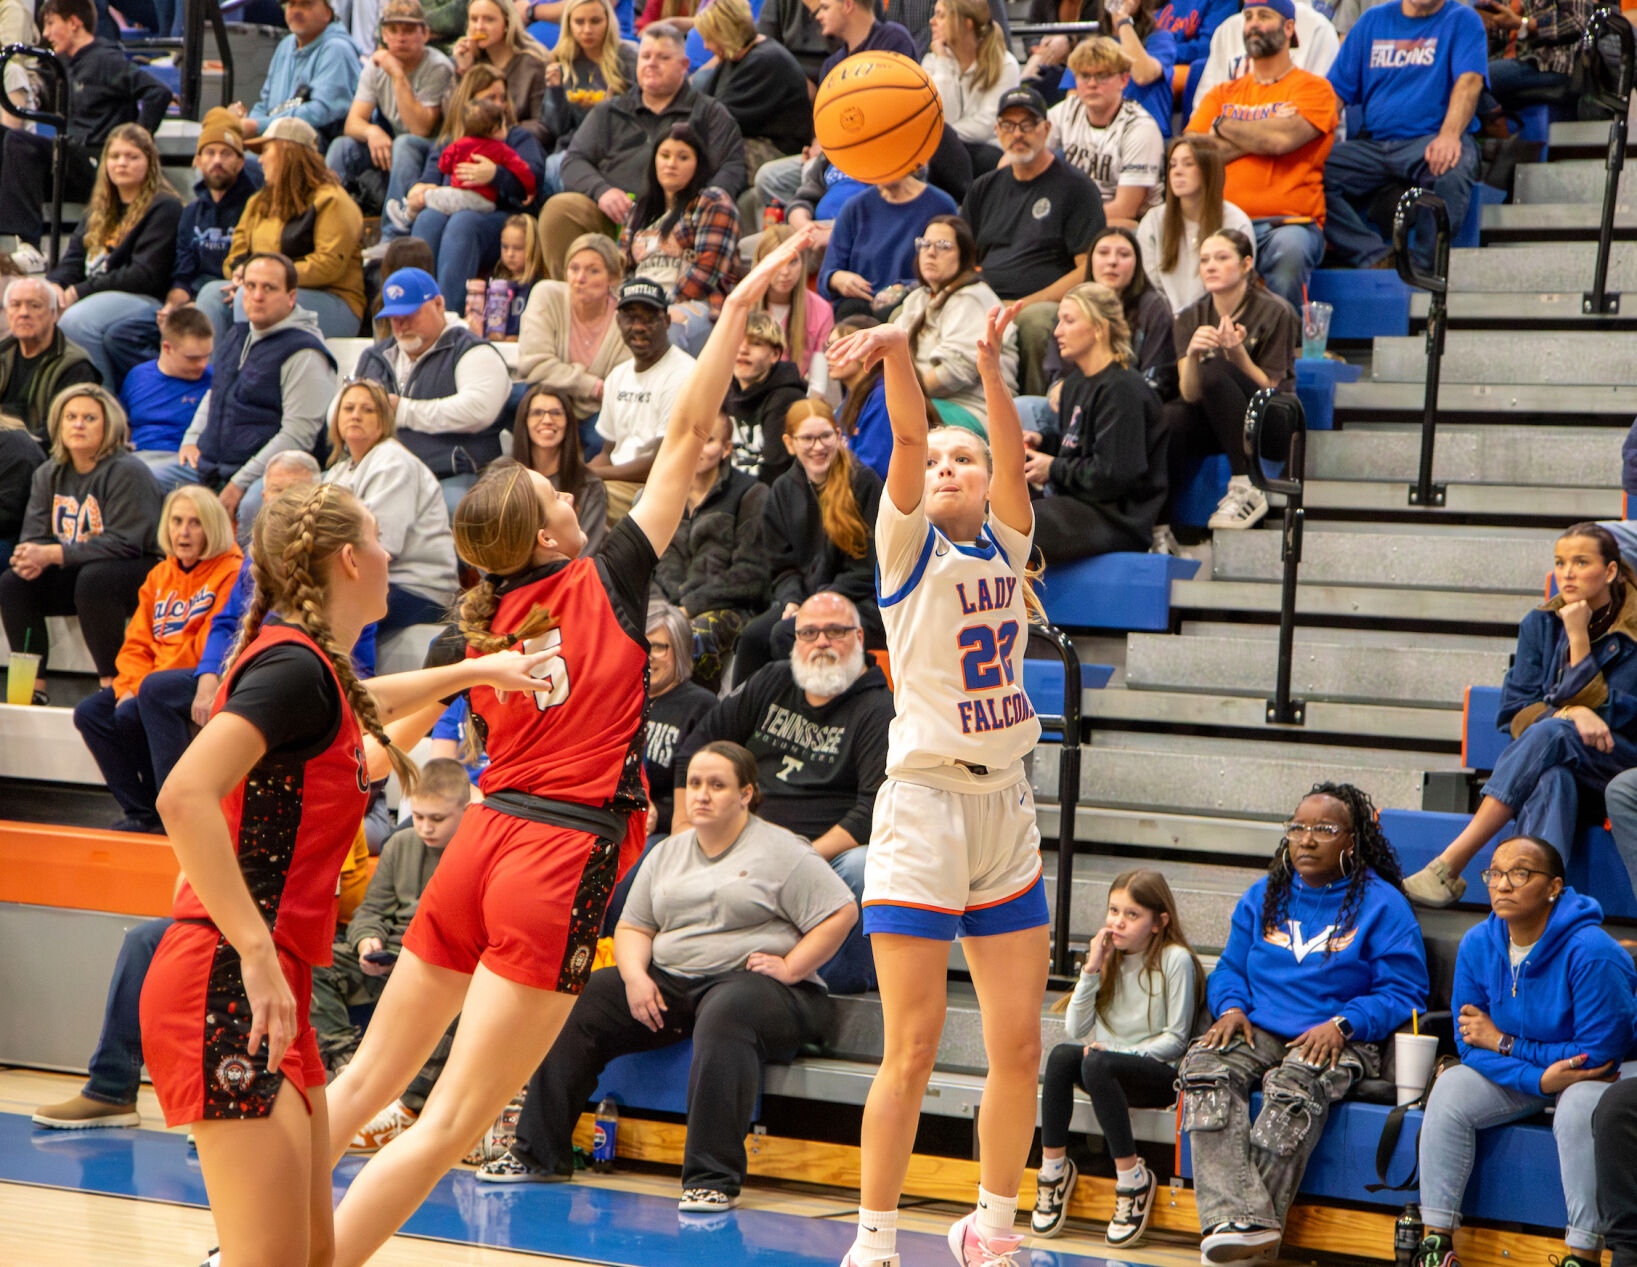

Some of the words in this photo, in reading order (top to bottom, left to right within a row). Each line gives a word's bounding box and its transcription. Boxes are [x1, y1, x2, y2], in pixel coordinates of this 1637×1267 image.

[956, 577, 1017, 616] LADY
[522, 627, 570, 713] 5
[957, 620, 1019, 692] 22
[761, 703, 846, 755] TENNSSEE
[775, 755, 804, 782] T
